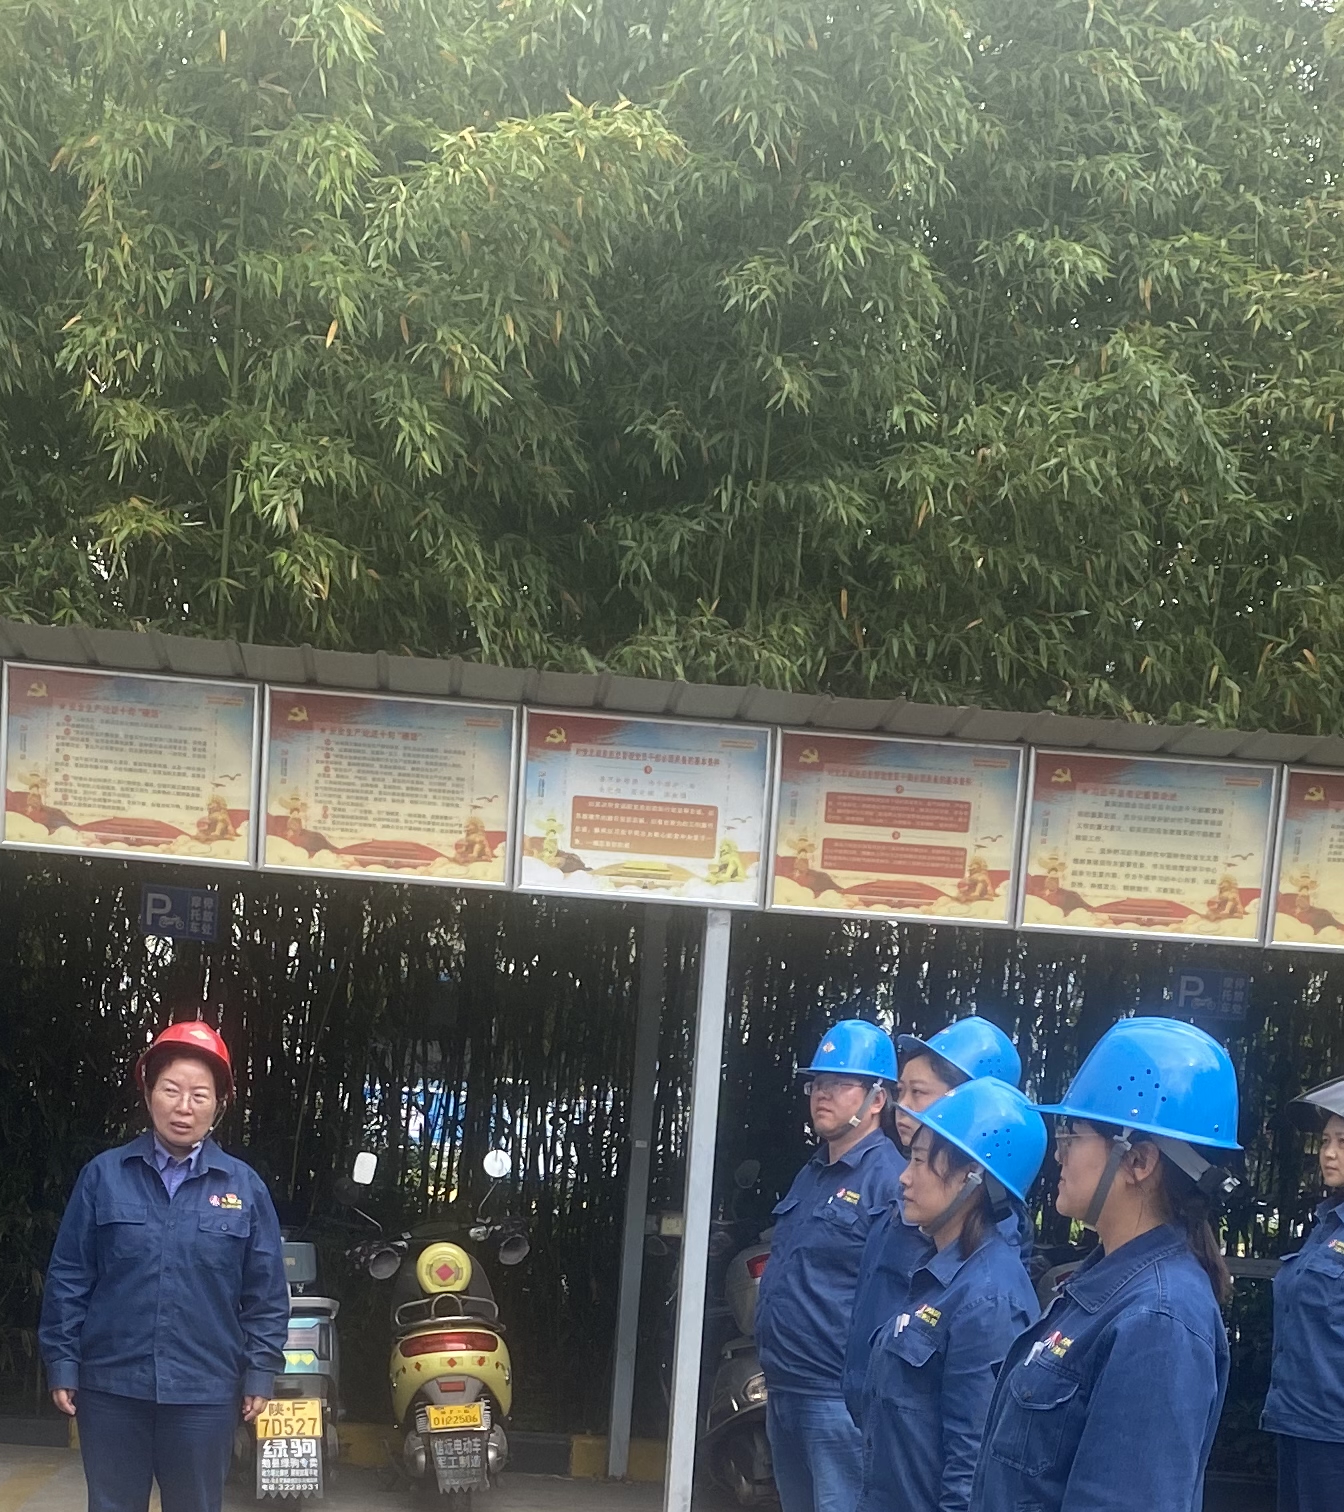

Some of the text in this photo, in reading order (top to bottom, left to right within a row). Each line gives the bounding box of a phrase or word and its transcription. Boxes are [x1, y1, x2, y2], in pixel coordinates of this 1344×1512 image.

[146, 893, 172, 925] P
[1179, 975, 1205, 1007] P
[260, 1418, 318, 1437] 7D527
[262, 1438, 316, 1458] 绿驹
